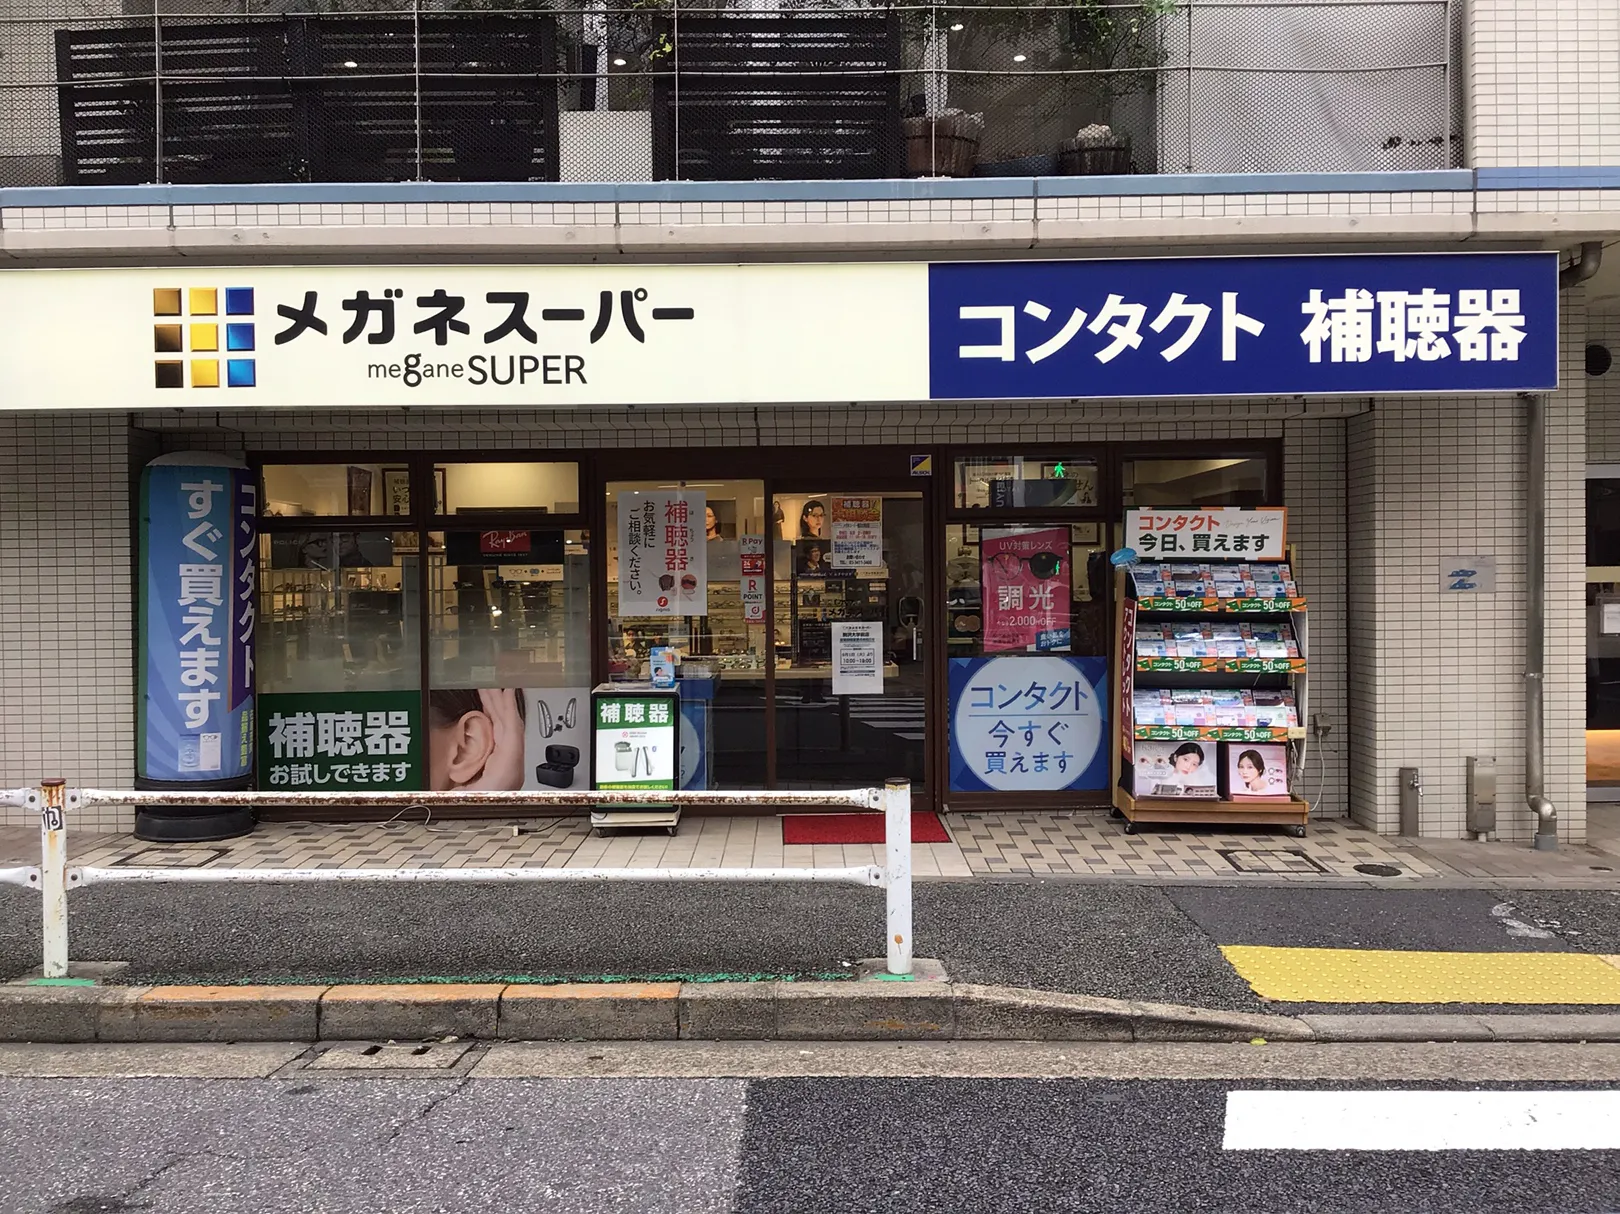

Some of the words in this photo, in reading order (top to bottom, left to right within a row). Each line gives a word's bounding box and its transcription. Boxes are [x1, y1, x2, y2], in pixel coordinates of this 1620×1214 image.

[274, 287, 694, 346] メガネスーパー
[959, 291, 1265, 364] コンタクト
[1300, 287, 1527, 363] 補聴器
[367, 353, 588, 388] meganeSUPER
[643, 500, 655, 548] お気軽に
[664, 500, 688, 571] 補聴器
[1139, 515, 1220, 532] コンタクト
[628, 508, 642, 595] ご相談ください。
[748, 538, 763, 546] Pay
[1000, 541, 1053, 551] UV対策レンズ
[1138, 533, 1270, 552] 今日、買えます
[238, 484, 256, 689] コンタクト
[997, 584, 1055, 611] 調光
[177, 479, 224, 730] すぐ買えます
[970, 680, 1089, 711] コンタクト
[600, 703, 669, 723] 補聴器
[268, 710, 412, 759] 補聴器
[988, 720, 1069, 748] 今すぐ
[268, 761, 412, 787] お試しできます
[983, 750, 1074, 775] 買えます
